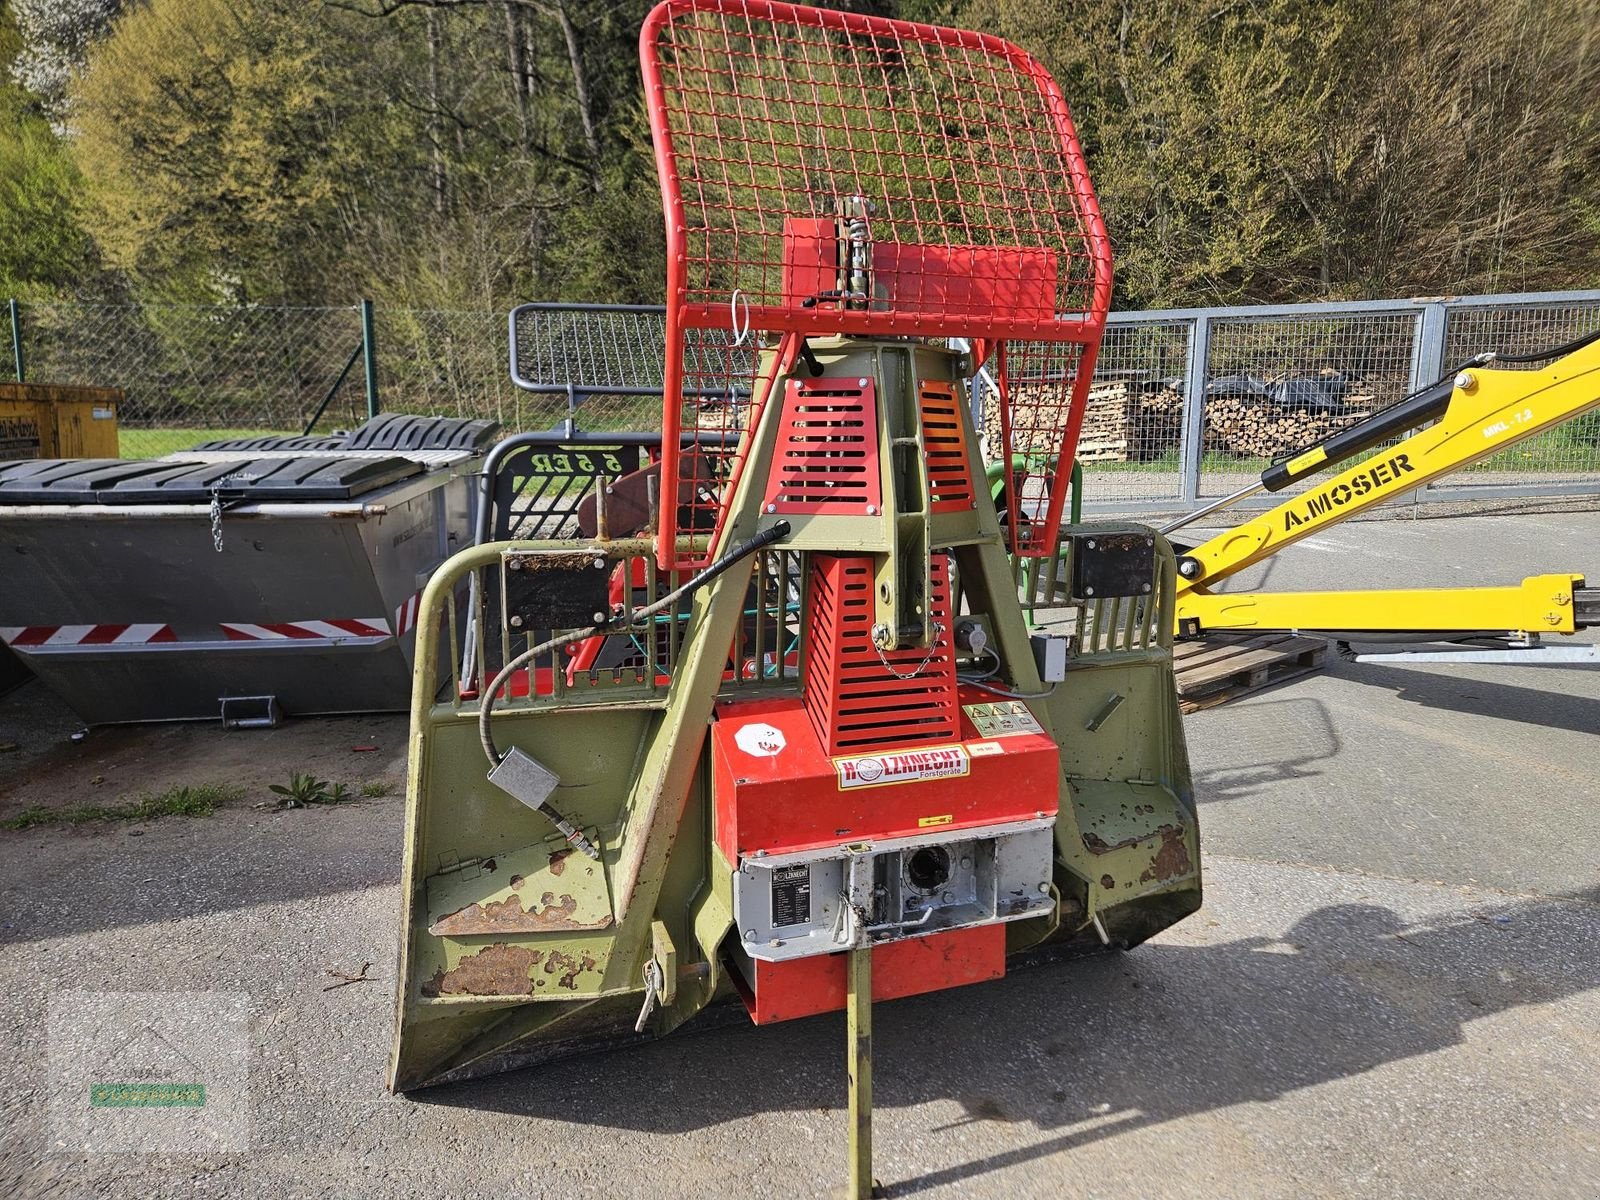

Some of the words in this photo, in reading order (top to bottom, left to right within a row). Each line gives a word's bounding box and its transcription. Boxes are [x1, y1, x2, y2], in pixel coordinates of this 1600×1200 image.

[1483, 422, 1510, 439] MKL
[1514, 409, 1534, 427] 7,2
[1284, 453, 1415, 531] A.MOSER
[842, 749, 962, 781] HOLZKNECHT
[919, 767, 962, 779] Forstgeräte
